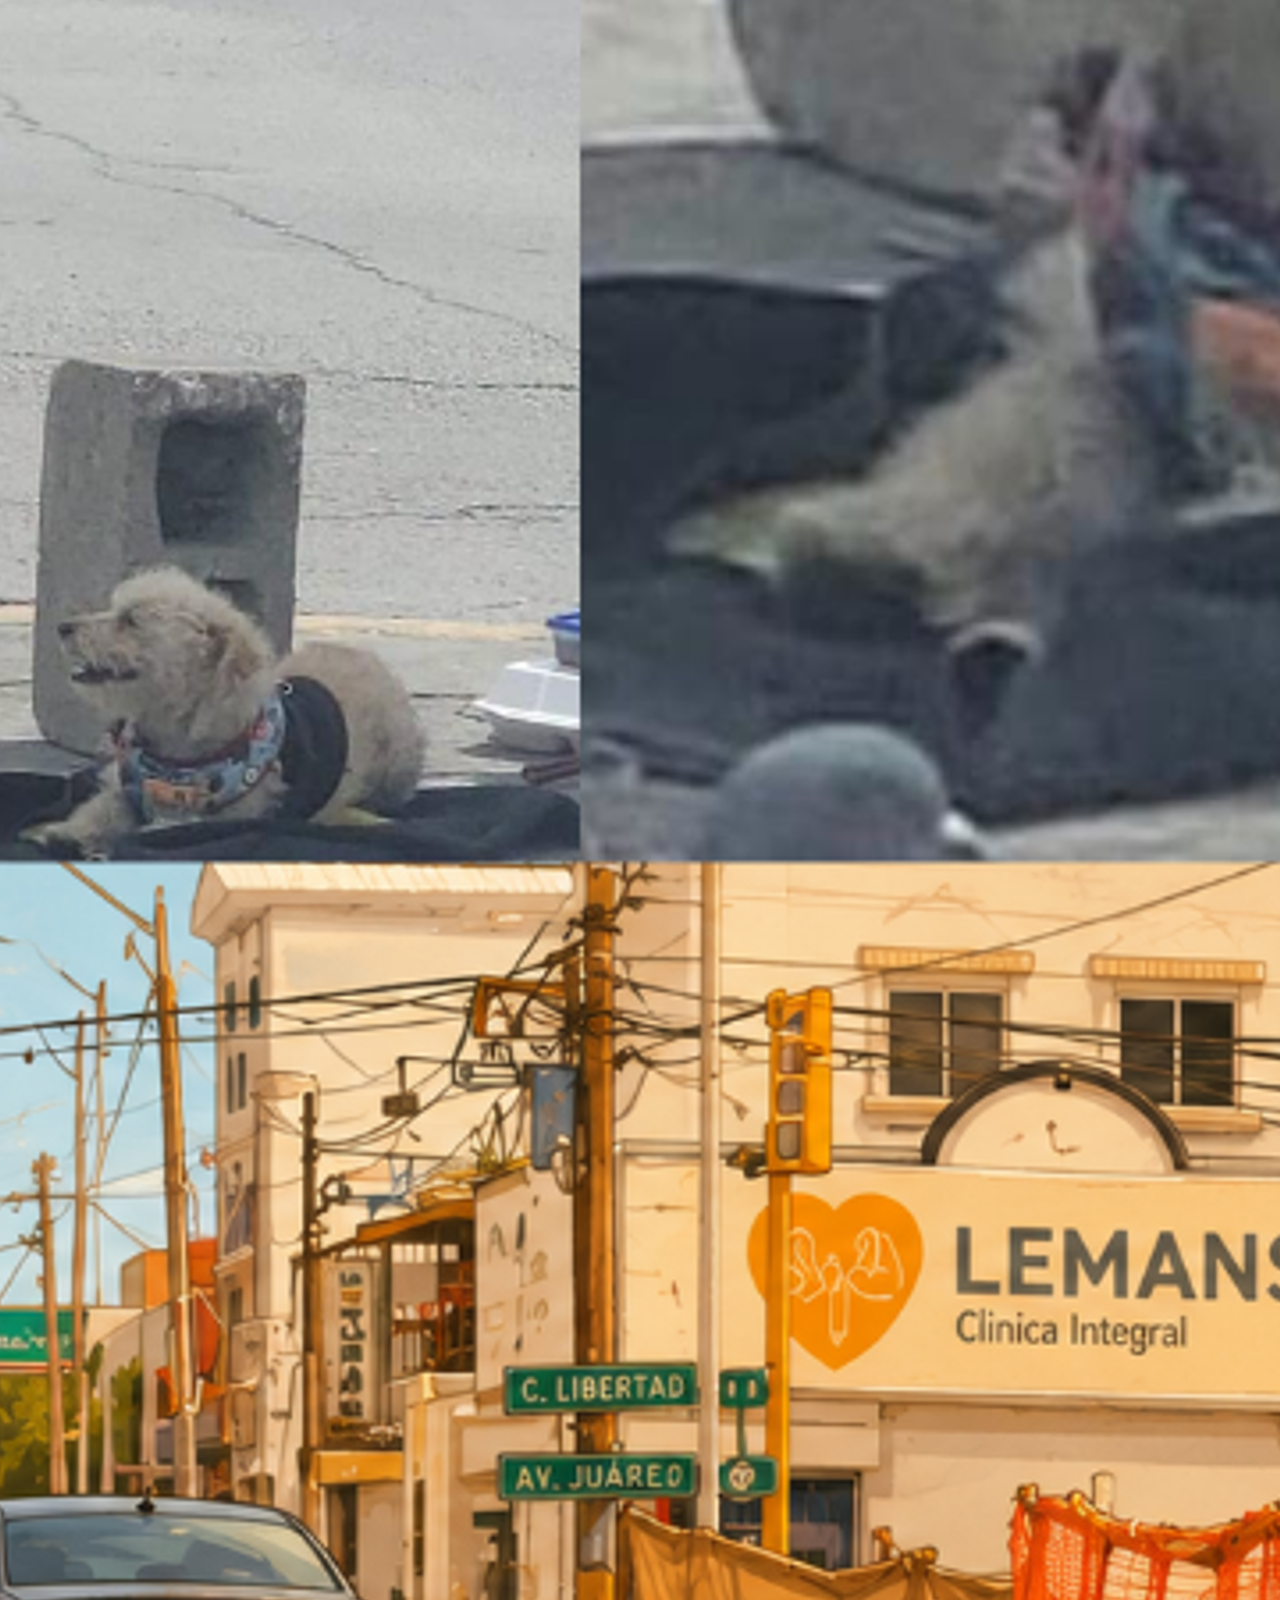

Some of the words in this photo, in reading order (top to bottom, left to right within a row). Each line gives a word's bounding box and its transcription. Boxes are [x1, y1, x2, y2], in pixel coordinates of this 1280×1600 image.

[956, 1308, 1058, 1344] Clinica
[1070, 1312, 1187, 1356] Integral
[521, 1376, 547, 1403] C.
[557, 1373, 685, 1402] LIBERTAD
[515, 1464, 561, 1492] AV.
